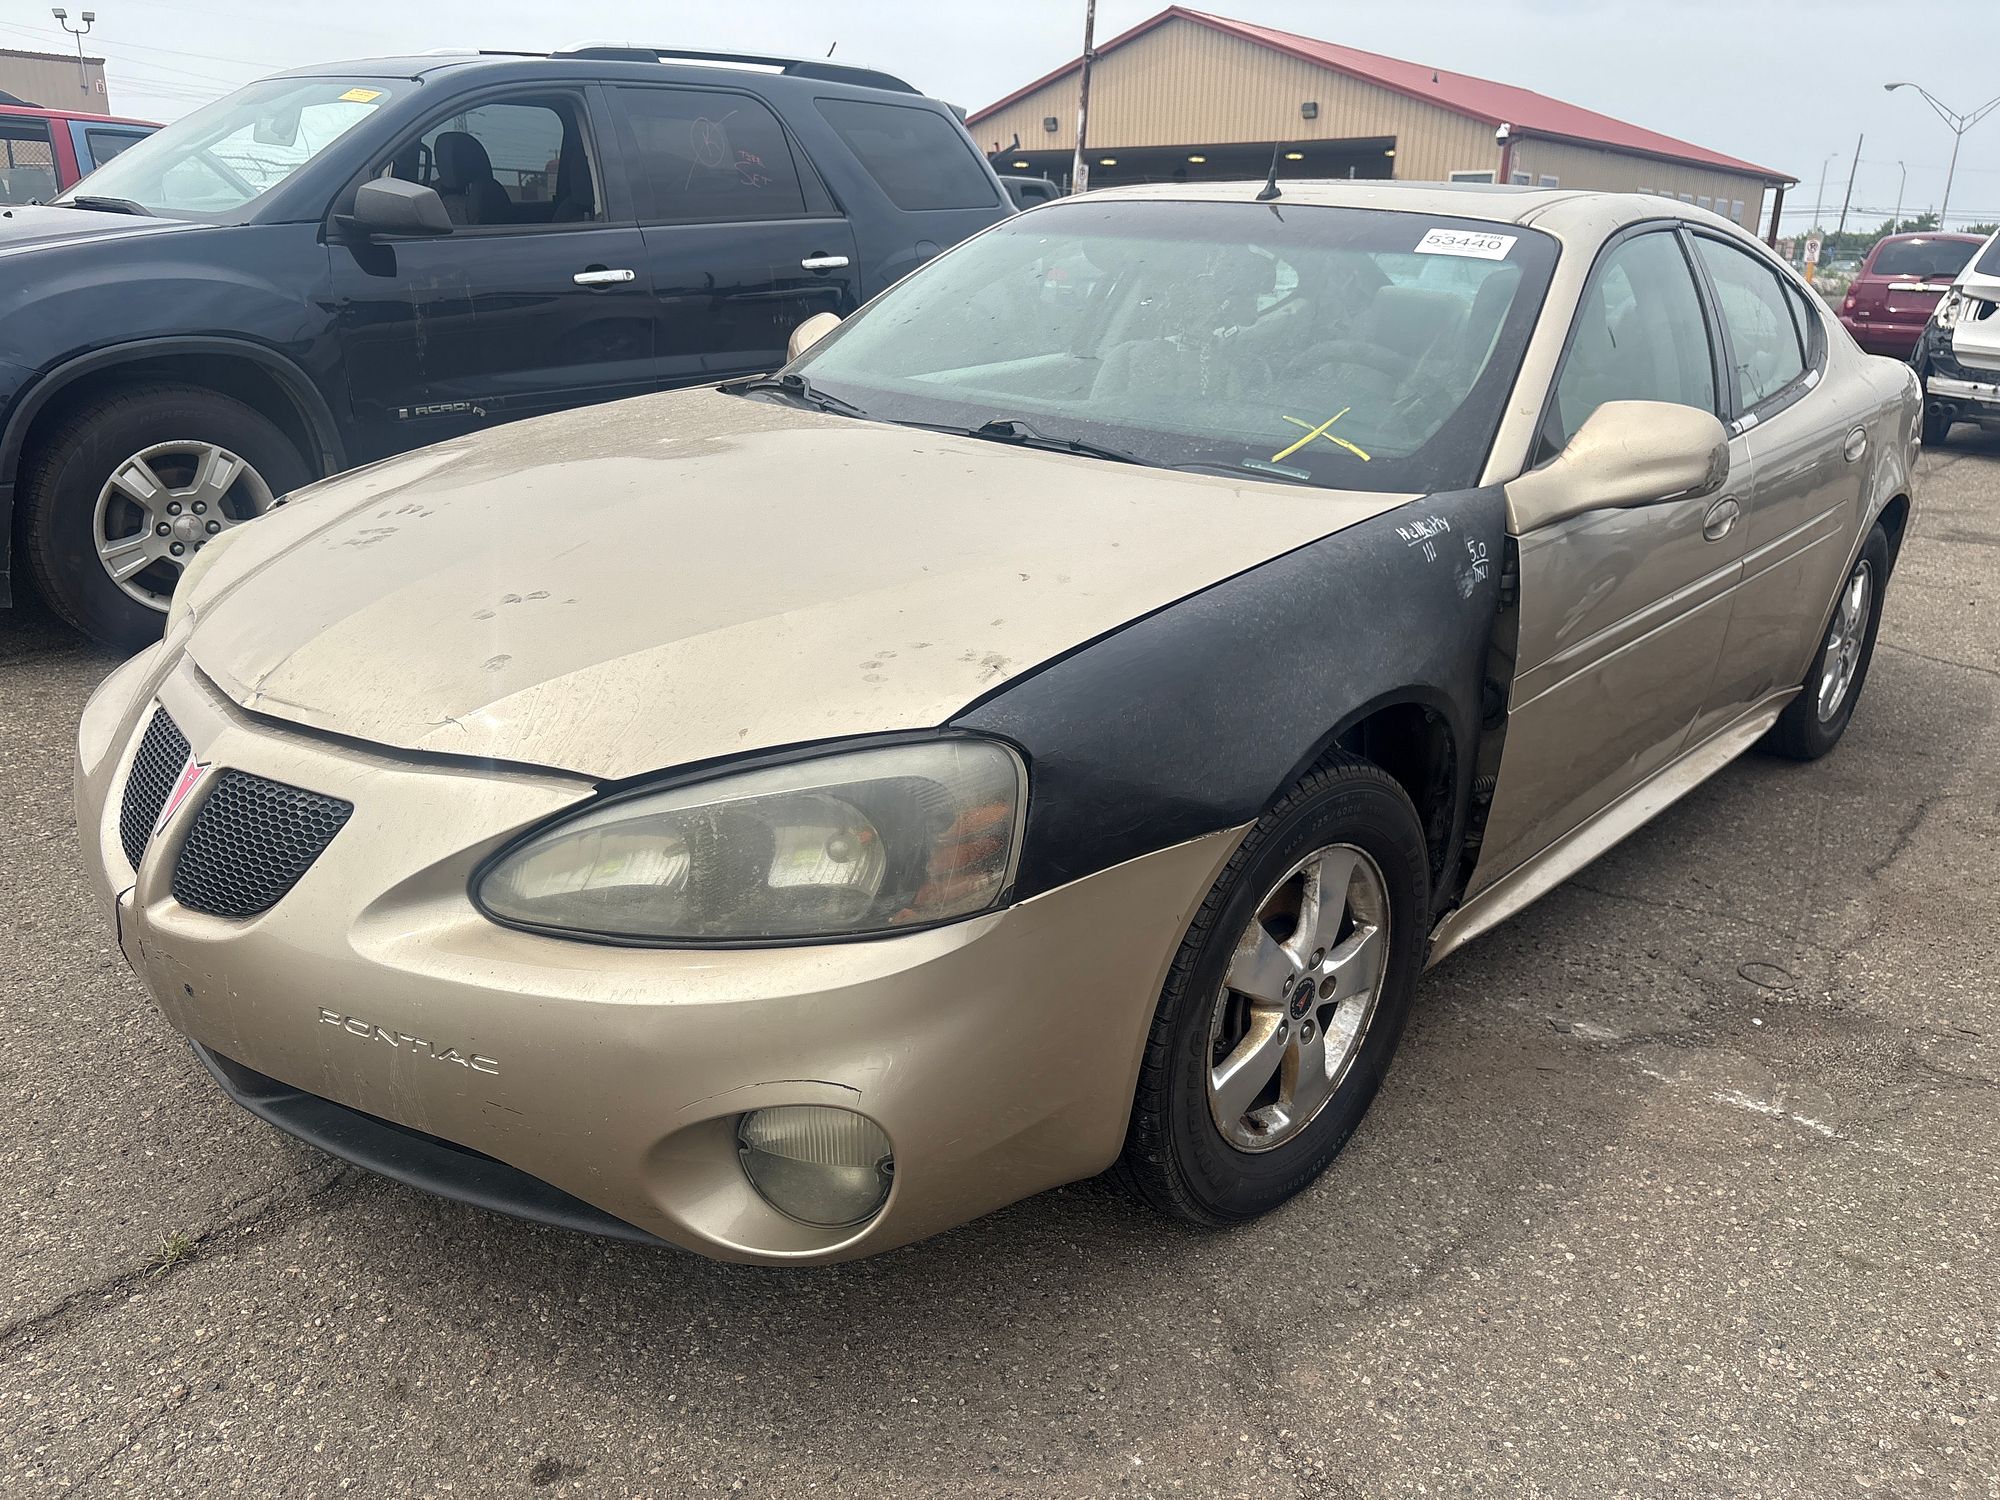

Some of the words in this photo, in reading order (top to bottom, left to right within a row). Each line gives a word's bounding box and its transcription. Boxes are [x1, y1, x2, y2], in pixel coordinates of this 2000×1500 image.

[98, 84, 103, 92] B
[1426, 235, 1502, 250] 53440
[1466, 540, 1487, 562] 5.0
[318, 1006, 500, 1075] PONTIAC
